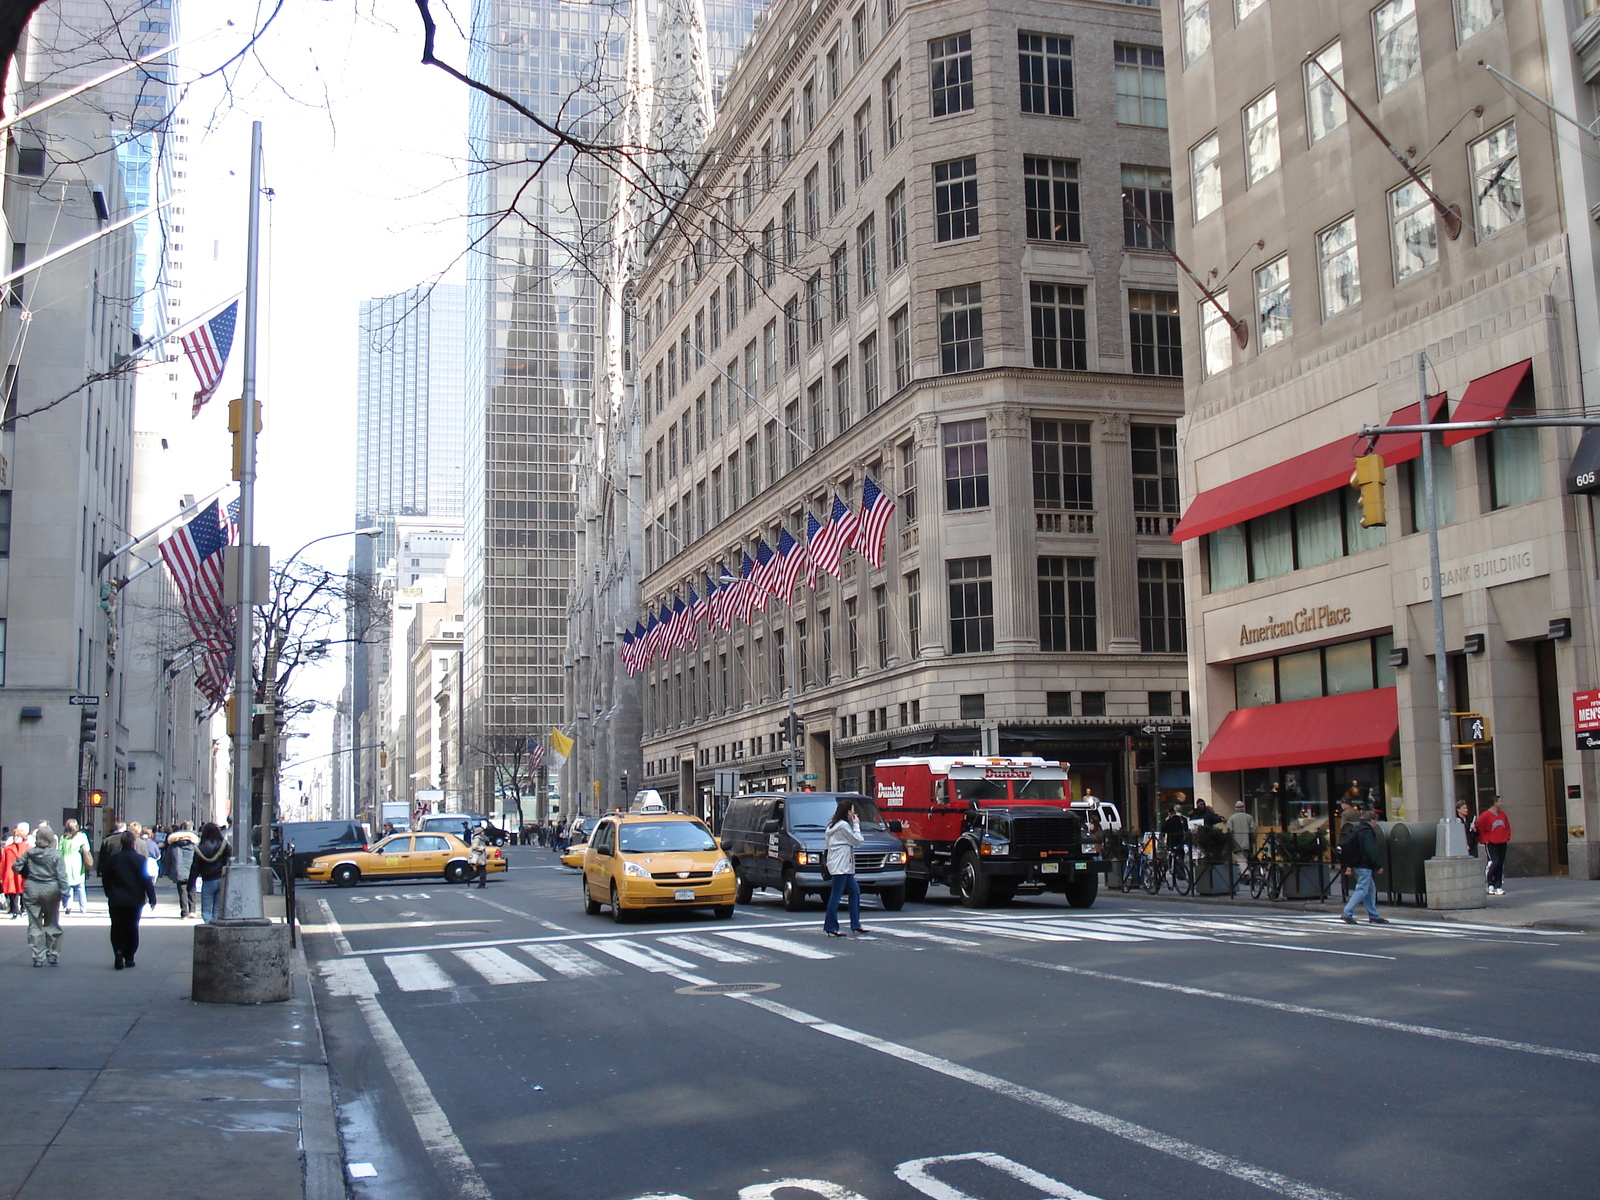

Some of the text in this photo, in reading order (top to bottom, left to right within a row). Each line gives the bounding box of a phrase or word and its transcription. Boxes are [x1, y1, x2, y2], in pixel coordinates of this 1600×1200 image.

[1576, 471, 1595, 487] 605
[1473, 552, 1531, 579] BUILDING
[1239, 604, 1351, 646] American Girl Place
[985, 768, 1032, 779] Dunbar
[877, 781, 905, 799] Dunbar
